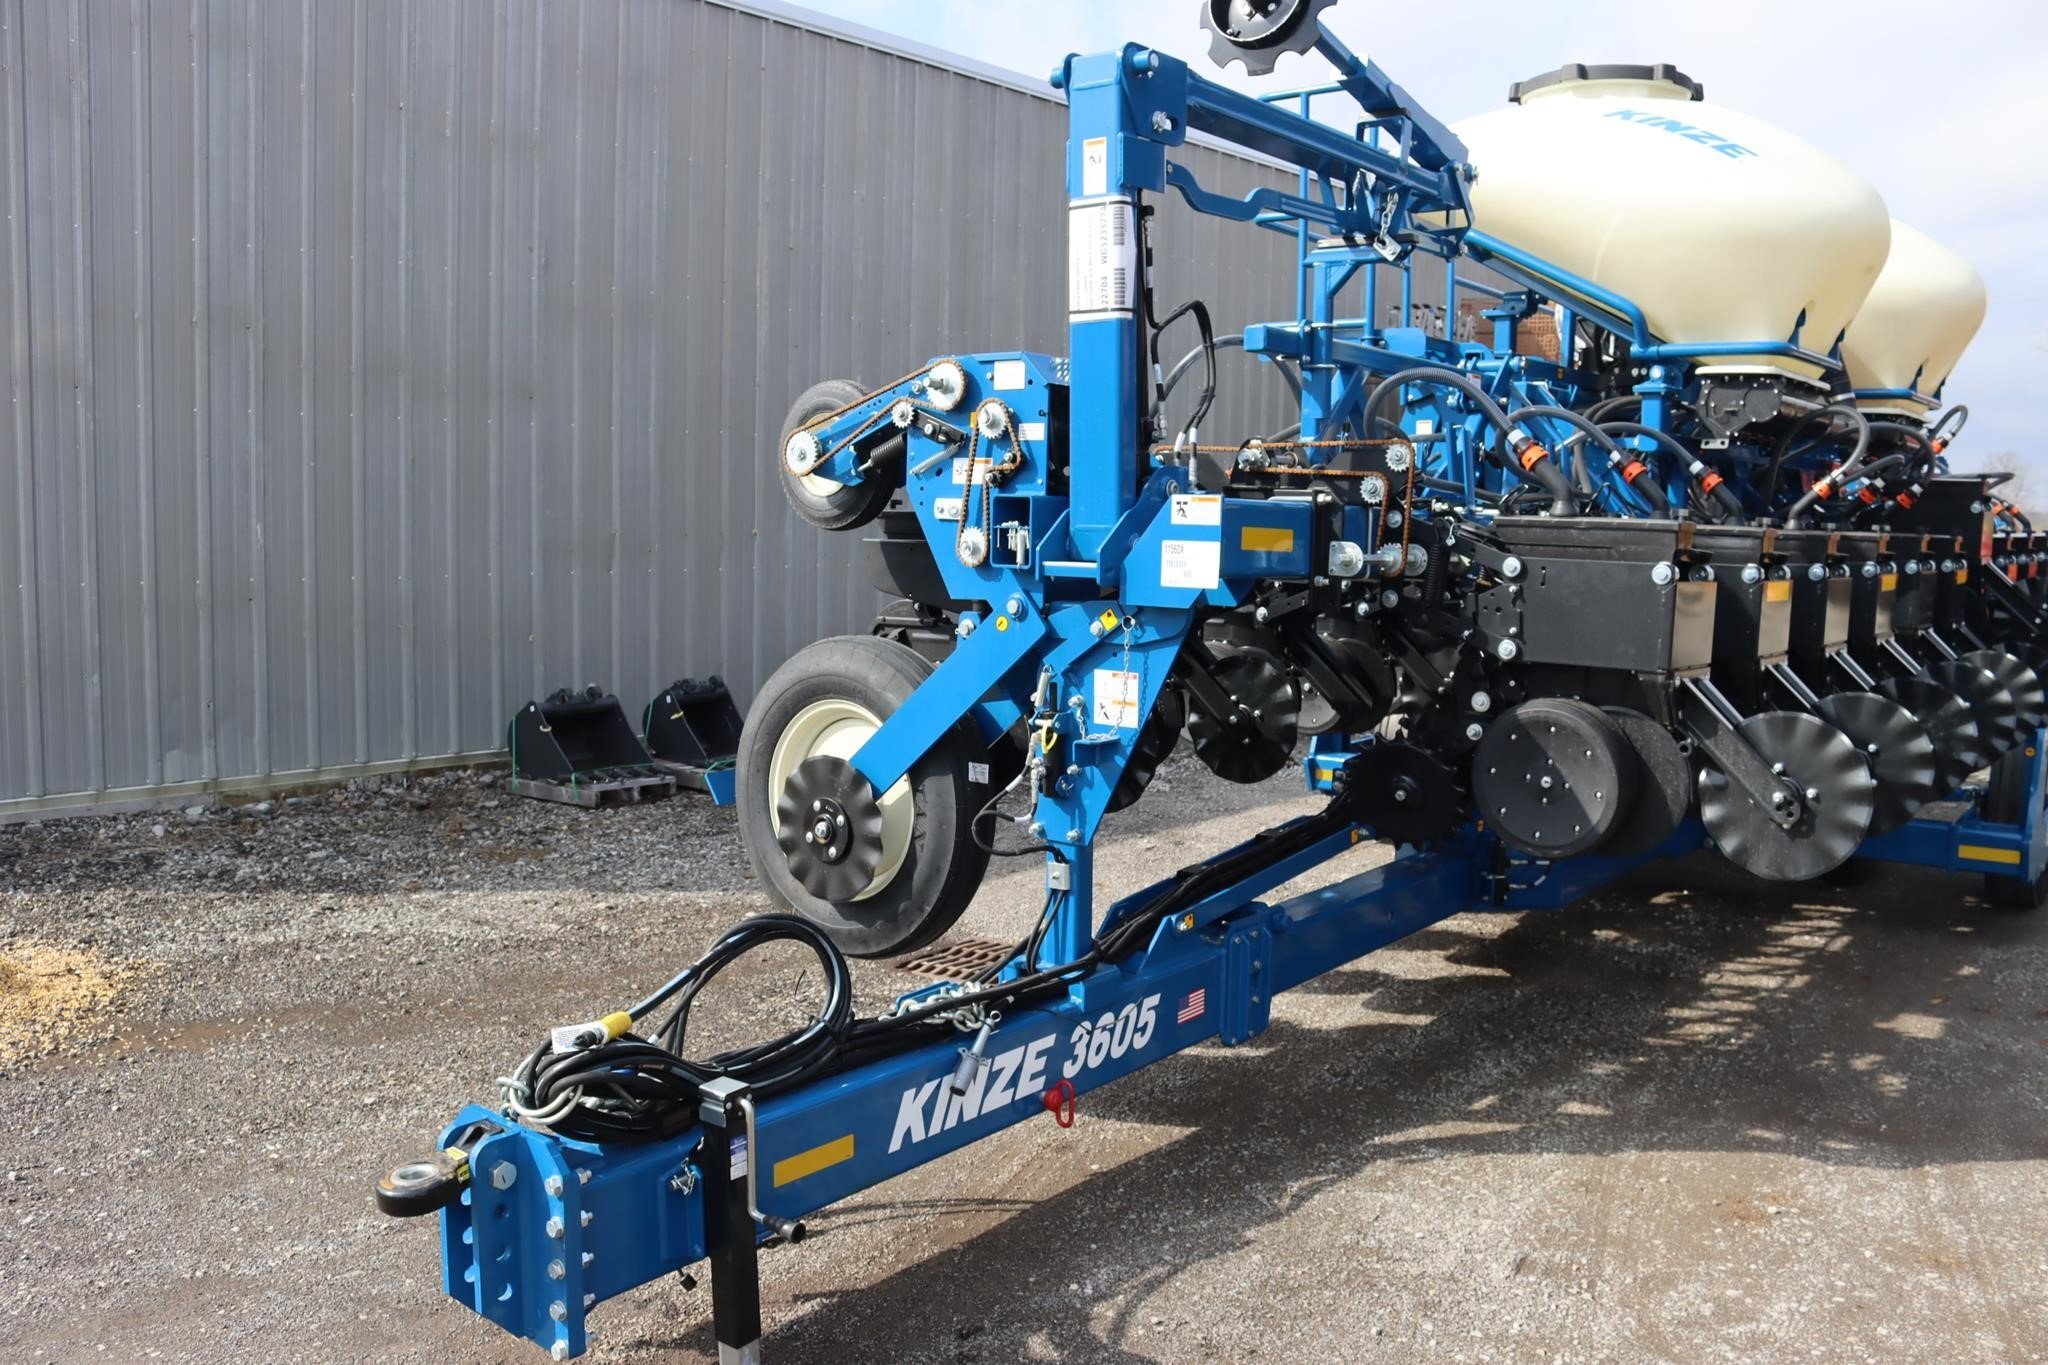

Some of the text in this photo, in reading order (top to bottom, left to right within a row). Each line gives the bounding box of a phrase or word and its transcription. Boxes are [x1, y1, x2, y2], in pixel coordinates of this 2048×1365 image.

[1602, 109, 1759, 159] KINZE
[888, 993, 1161, 1155] KINZE 3605
